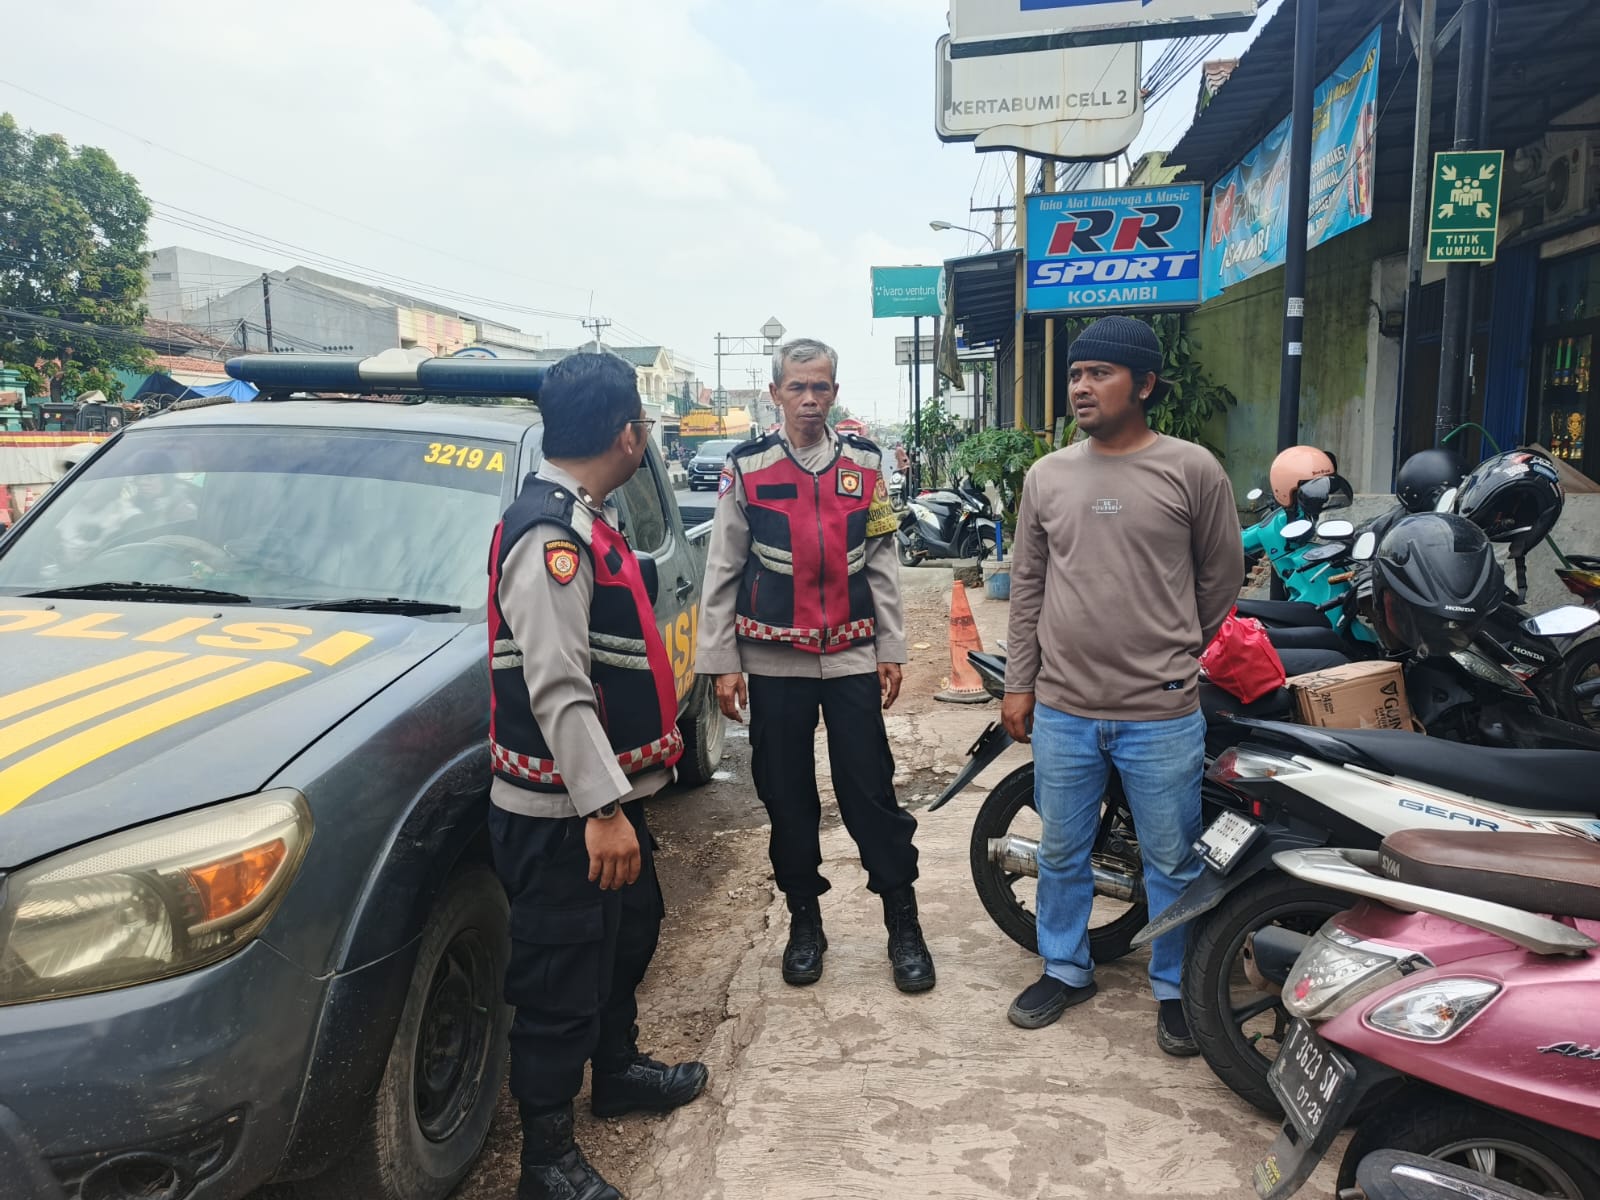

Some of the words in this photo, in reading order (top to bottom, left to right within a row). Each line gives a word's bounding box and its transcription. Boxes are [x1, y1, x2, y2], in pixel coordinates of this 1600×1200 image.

[952, 95, 1060, 115] KERTABUMI
[1066, 91, 1112, 108] CELL
[1117, 90, 1127, 104] 2
[1040, 199, 1063, 211] Toko
[1066, 197, 1089, 209] Alat
[1091, 194, 1142, 207] Olahraga
[1145, 192, 1153, 203] &
[1156, 188, 1190, 202] Music
[1045, 204, 1183, 257] RR
[1446, 235, 1480, 244] TITIK
[1437, 246, 1487, 256] KUMPUL
[1033, 254, 1197, 285] SPORT
[1068, 286, 1158, 304] KOSAMBI
[424, 443, 484, 469] 3219
[485, 452, 504, 472] A
[1513, 645, 1545, 662] HONDA
[1398, 799, 1499, 832] GEAR
[1382, 855, 1400, 878] SYM
[1295, 1035, 1323, 1081] 3623
[1319, 1065, 1340, 1102] SN
